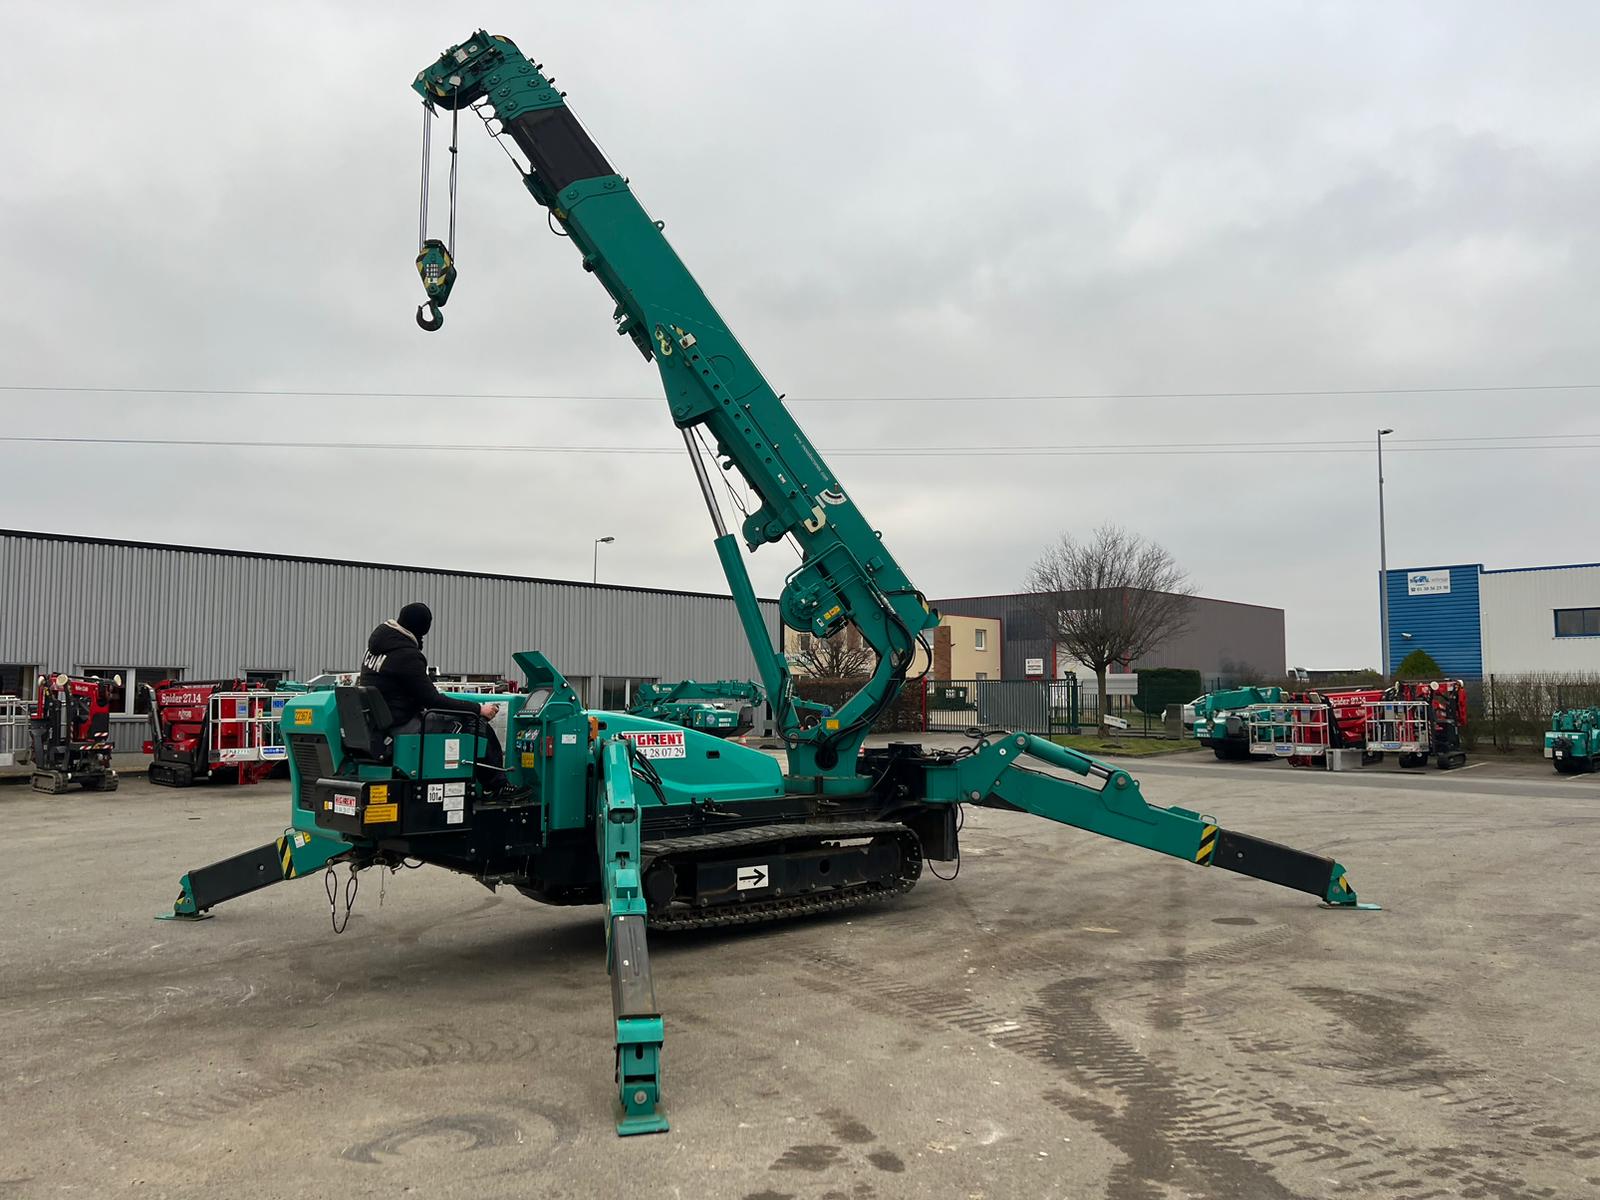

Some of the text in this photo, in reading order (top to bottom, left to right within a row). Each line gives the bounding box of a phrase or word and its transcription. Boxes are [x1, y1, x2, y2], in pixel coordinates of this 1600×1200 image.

[161, 693, 201, 705] Spider 27.14
[650, 748, 660, 757] 28
[662, 748, 671, 757] 07
[675, 747, 684, 757] 29
